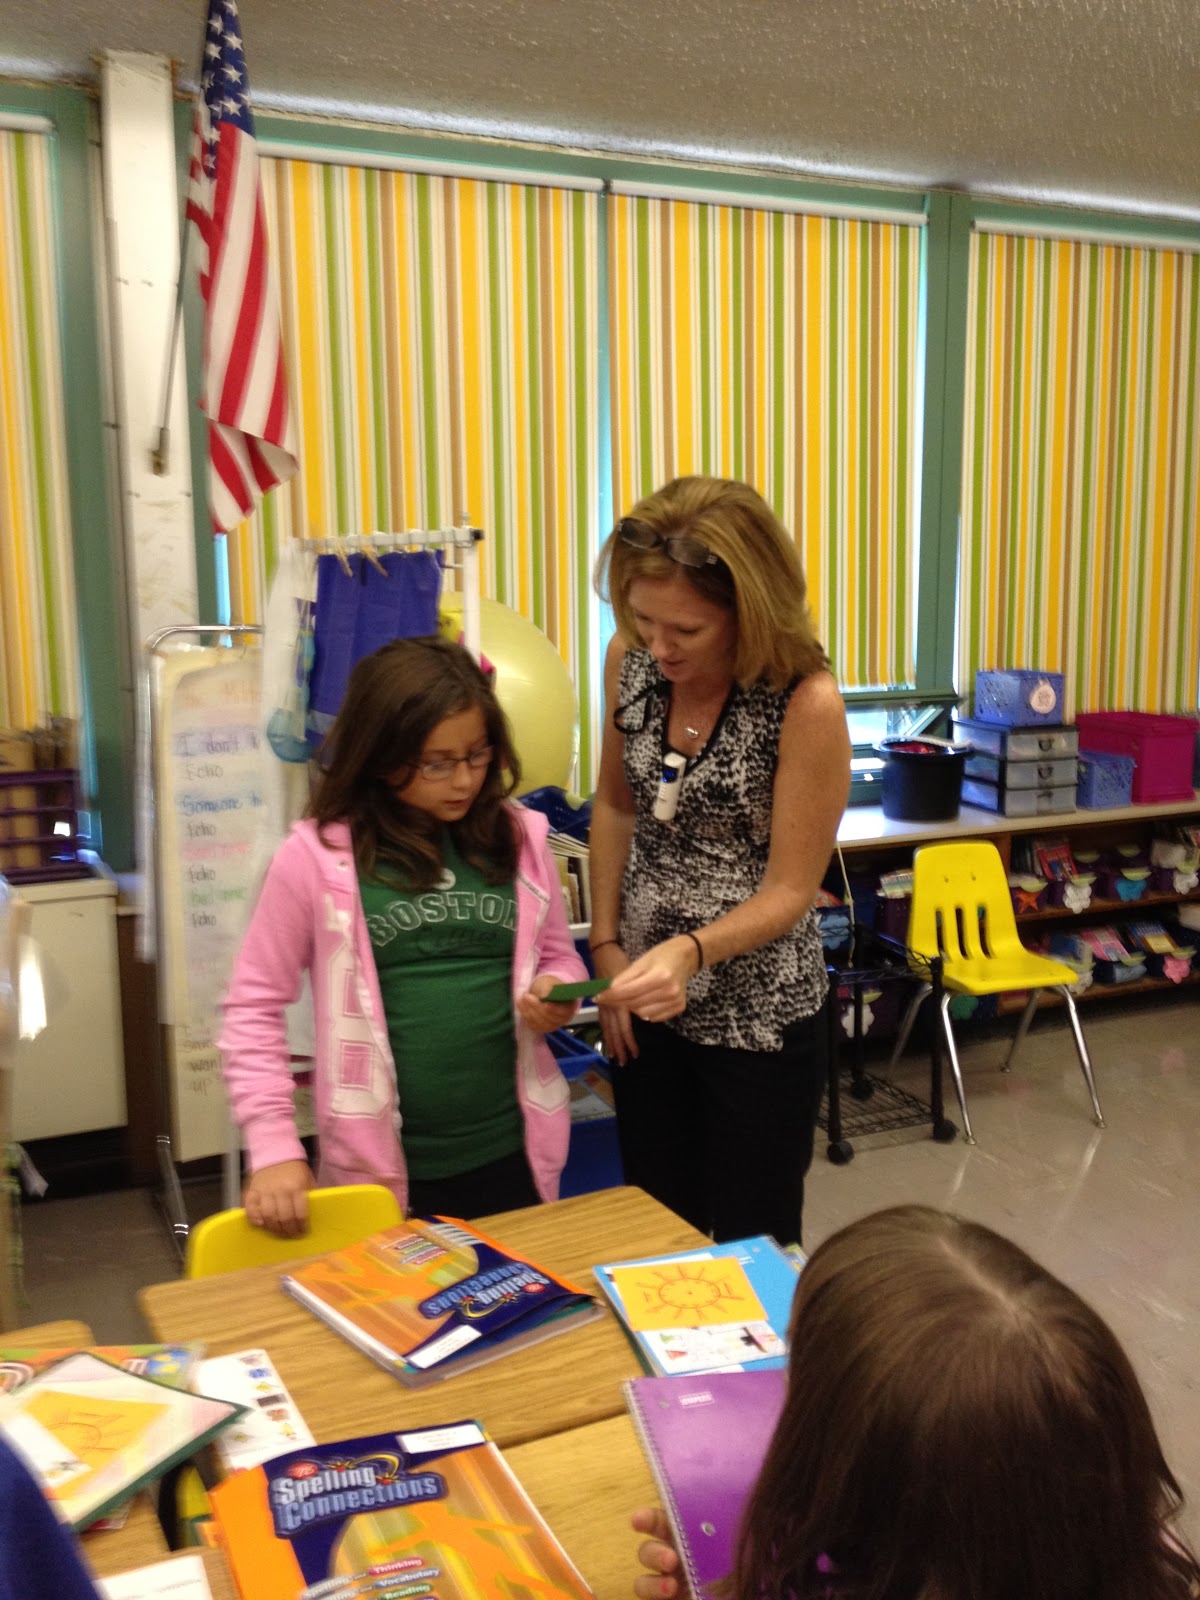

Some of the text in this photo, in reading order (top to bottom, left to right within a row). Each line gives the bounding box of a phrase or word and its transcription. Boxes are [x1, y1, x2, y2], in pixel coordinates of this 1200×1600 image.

[476, 1272, 551, 1305] Spelling
[276, 1466, 377, 1505] Spelling
[282, 1477, 438, 1530] Connections
[373, 1557, 423, 1574] Thinking
[379, 1568, 441, 1587] Vocabulary
[385, 1584, 431, 1600] Reading
